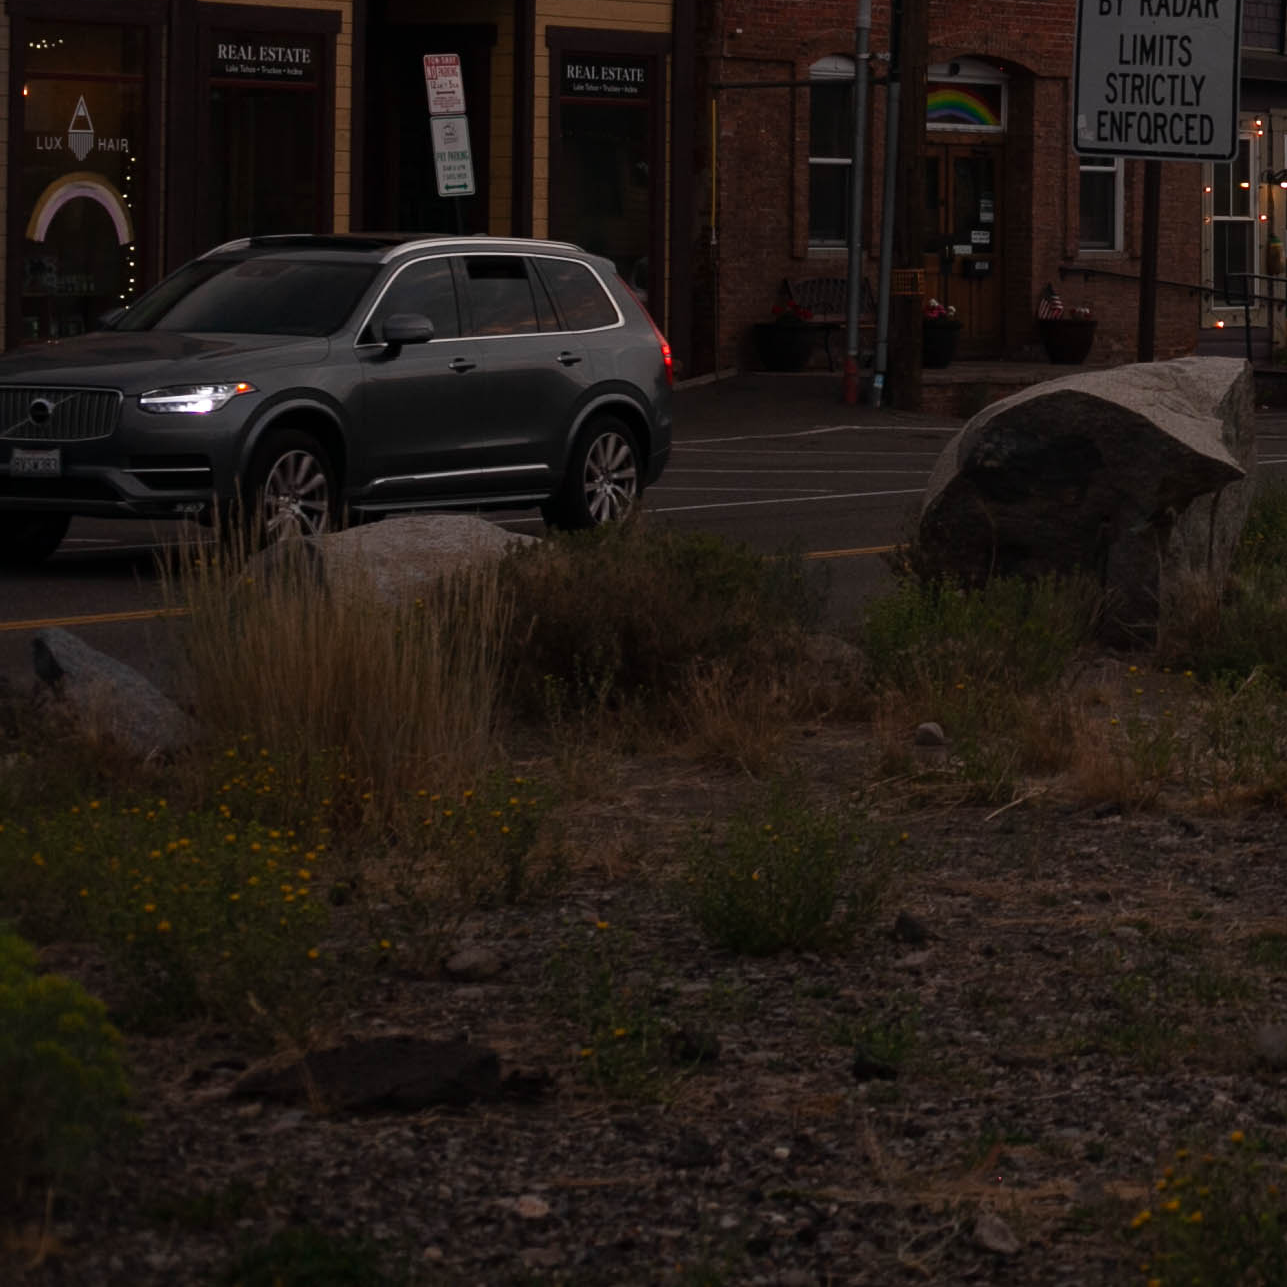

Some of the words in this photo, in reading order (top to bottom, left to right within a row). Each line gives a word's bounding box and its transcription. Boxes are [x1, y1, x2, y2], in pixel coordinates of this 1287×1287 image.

[217, 43, 257, 61] REAL
[259, 46, 312, 65] ESTATE
[1118, 34, 1192, 67] LIMITS
[567, 64, 599, 80] REAL
[601, 66, 645, 82] ESTATE
[1105, 72, 1205, 107] STRICTLY
[1097, 110, 1214, 145] ENFORCED
[36, 137, 62, 150] LUX
[98, 139, 129, 153] HAIR
